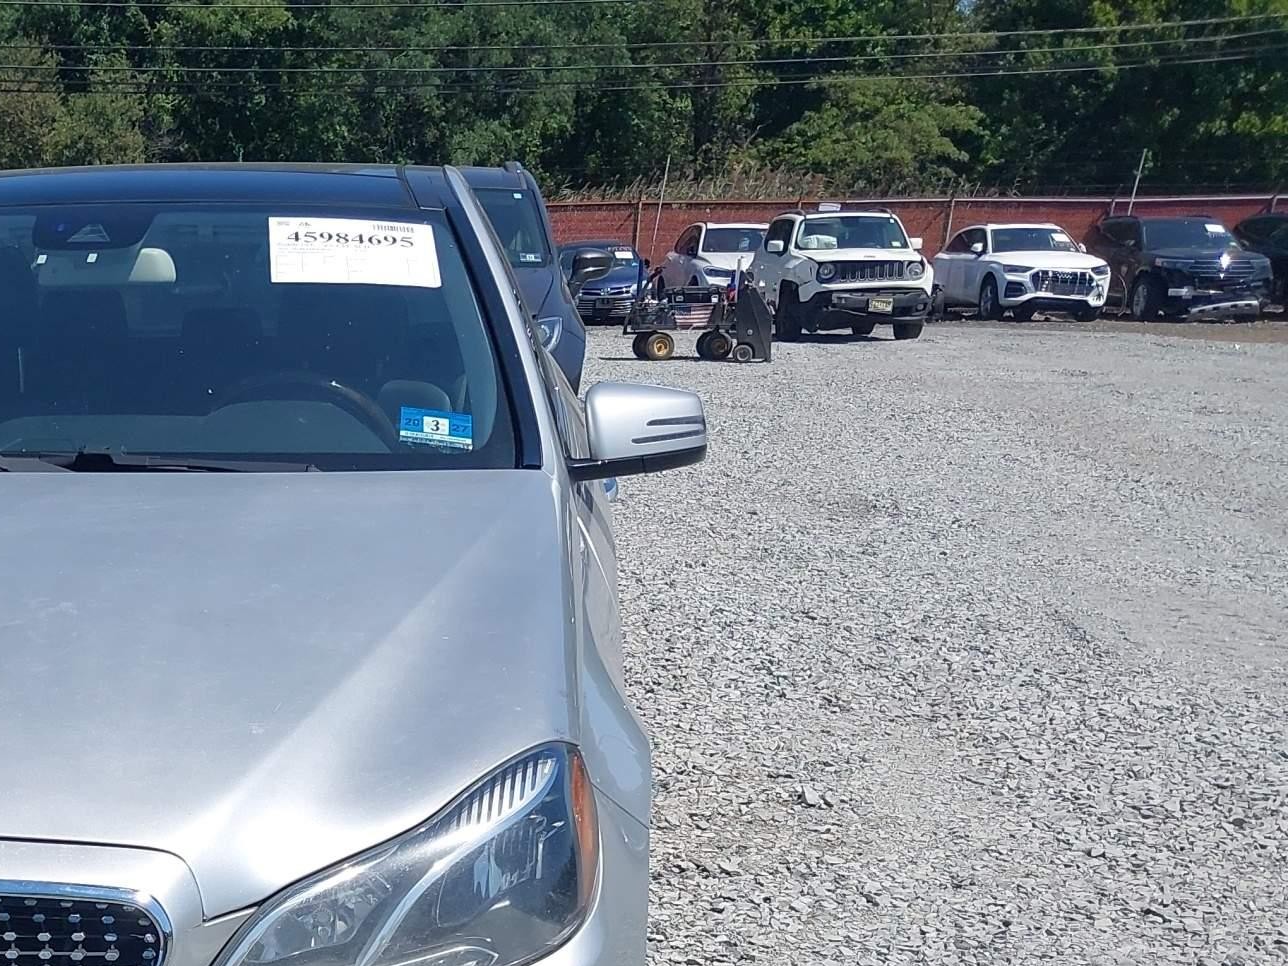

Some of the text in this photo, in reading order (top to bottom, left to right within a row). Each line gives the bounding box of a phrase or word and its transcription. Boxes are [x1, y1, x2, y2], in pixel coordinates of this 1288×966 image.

[287, 231, 415, 248] 45984695
[404, 417, 421, 427] 20
[430, 419, 441, 432] 3
